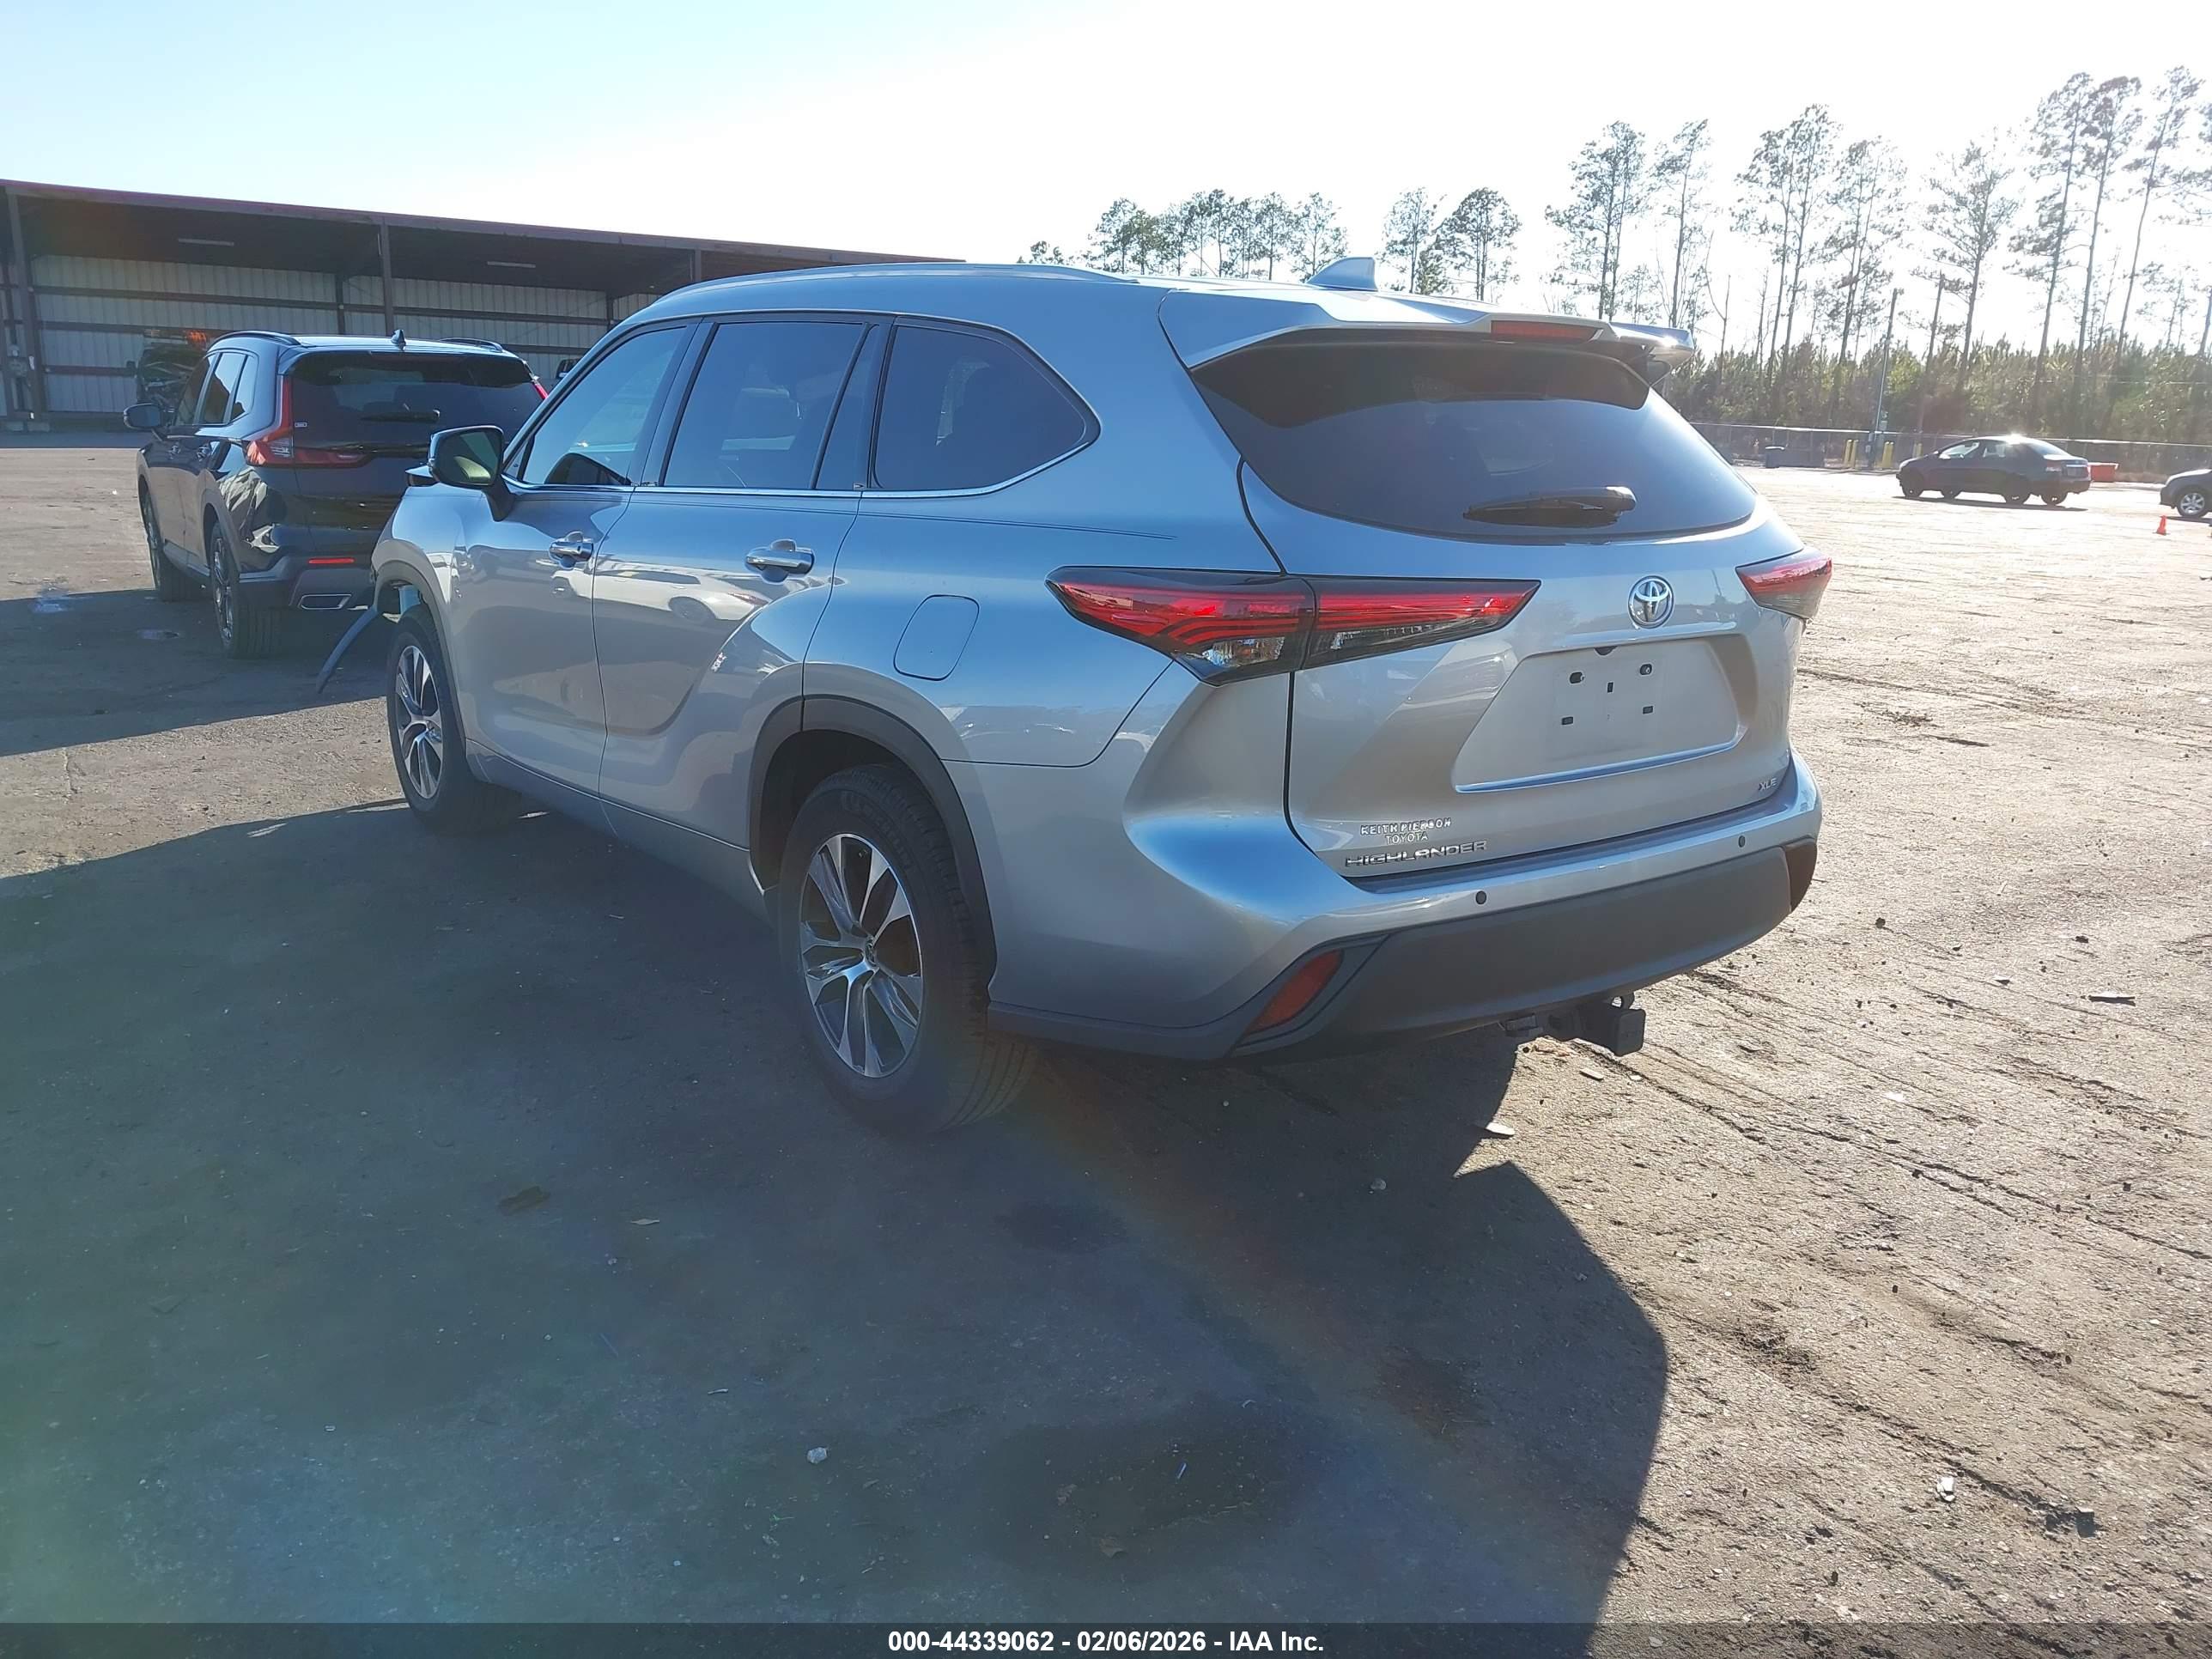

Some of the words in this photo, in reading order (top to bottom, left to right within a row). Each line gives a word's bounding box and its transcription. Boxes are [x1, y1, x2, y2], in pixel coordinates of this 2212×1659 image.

[1759, 777, 1778, 791] XLE
[1360, 823, 1398, 836] KEITH
[1385, 830, 1429, 845] TOYOTA
[1346, 840, 1487, 867] HIGHLANDER
